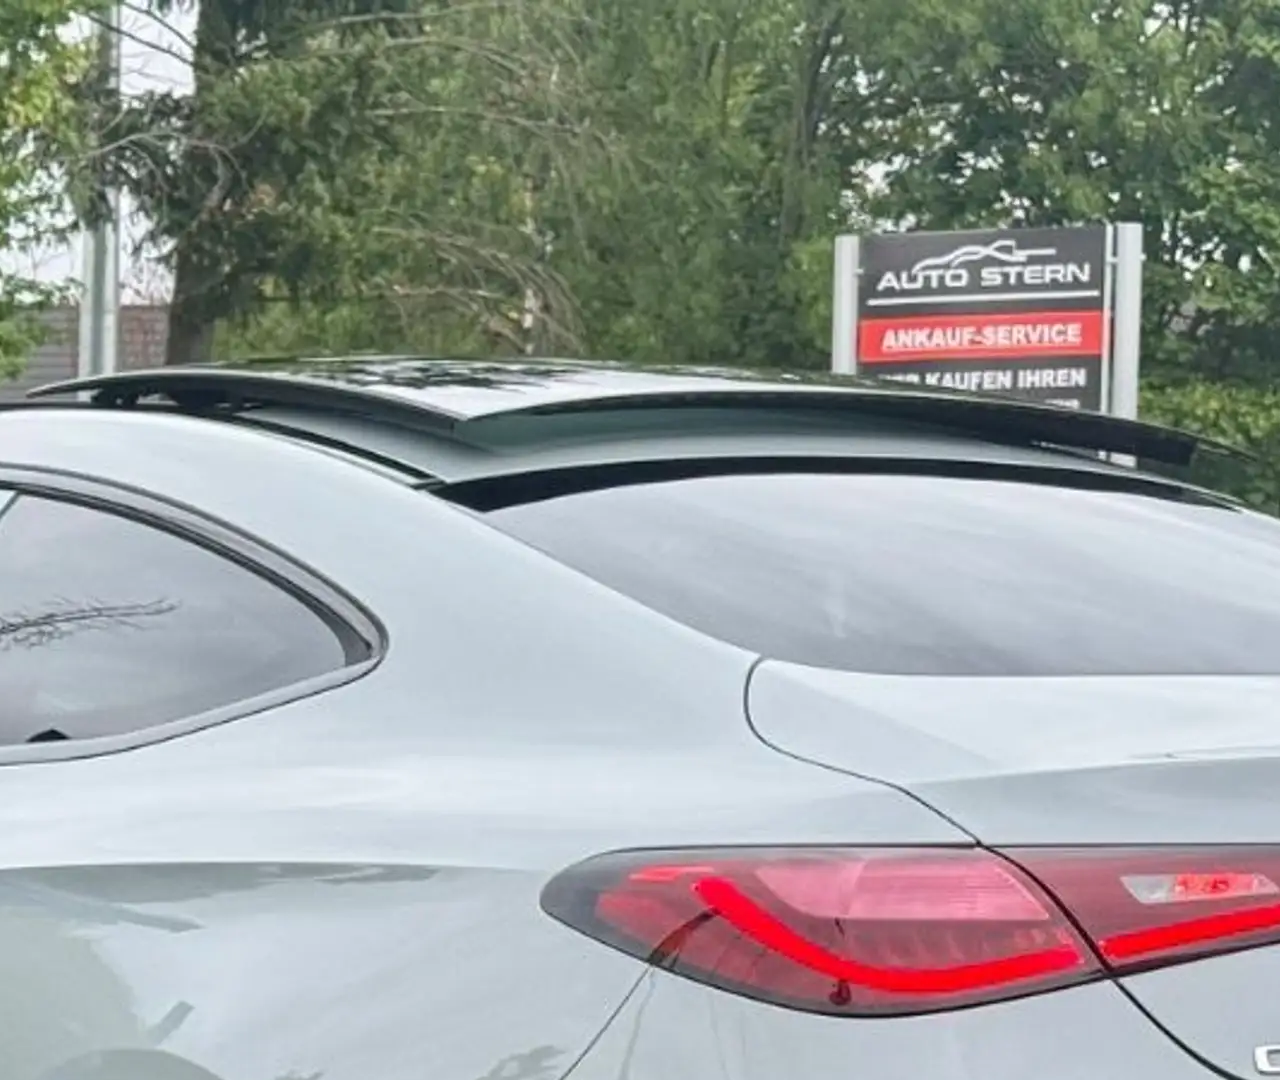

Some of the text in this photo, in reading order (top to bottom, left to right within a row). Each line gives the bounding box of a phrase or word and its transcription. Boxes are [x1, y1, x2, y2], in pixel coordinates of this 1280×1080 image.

[877, 263, 1090, 290] AUTO STERN
[882, 323, 1082, 351] ANKAUF-SERVICE
[925, 370, 1012, 391] KAUFEN
[1018, 368, 1086, 389] IHREN
